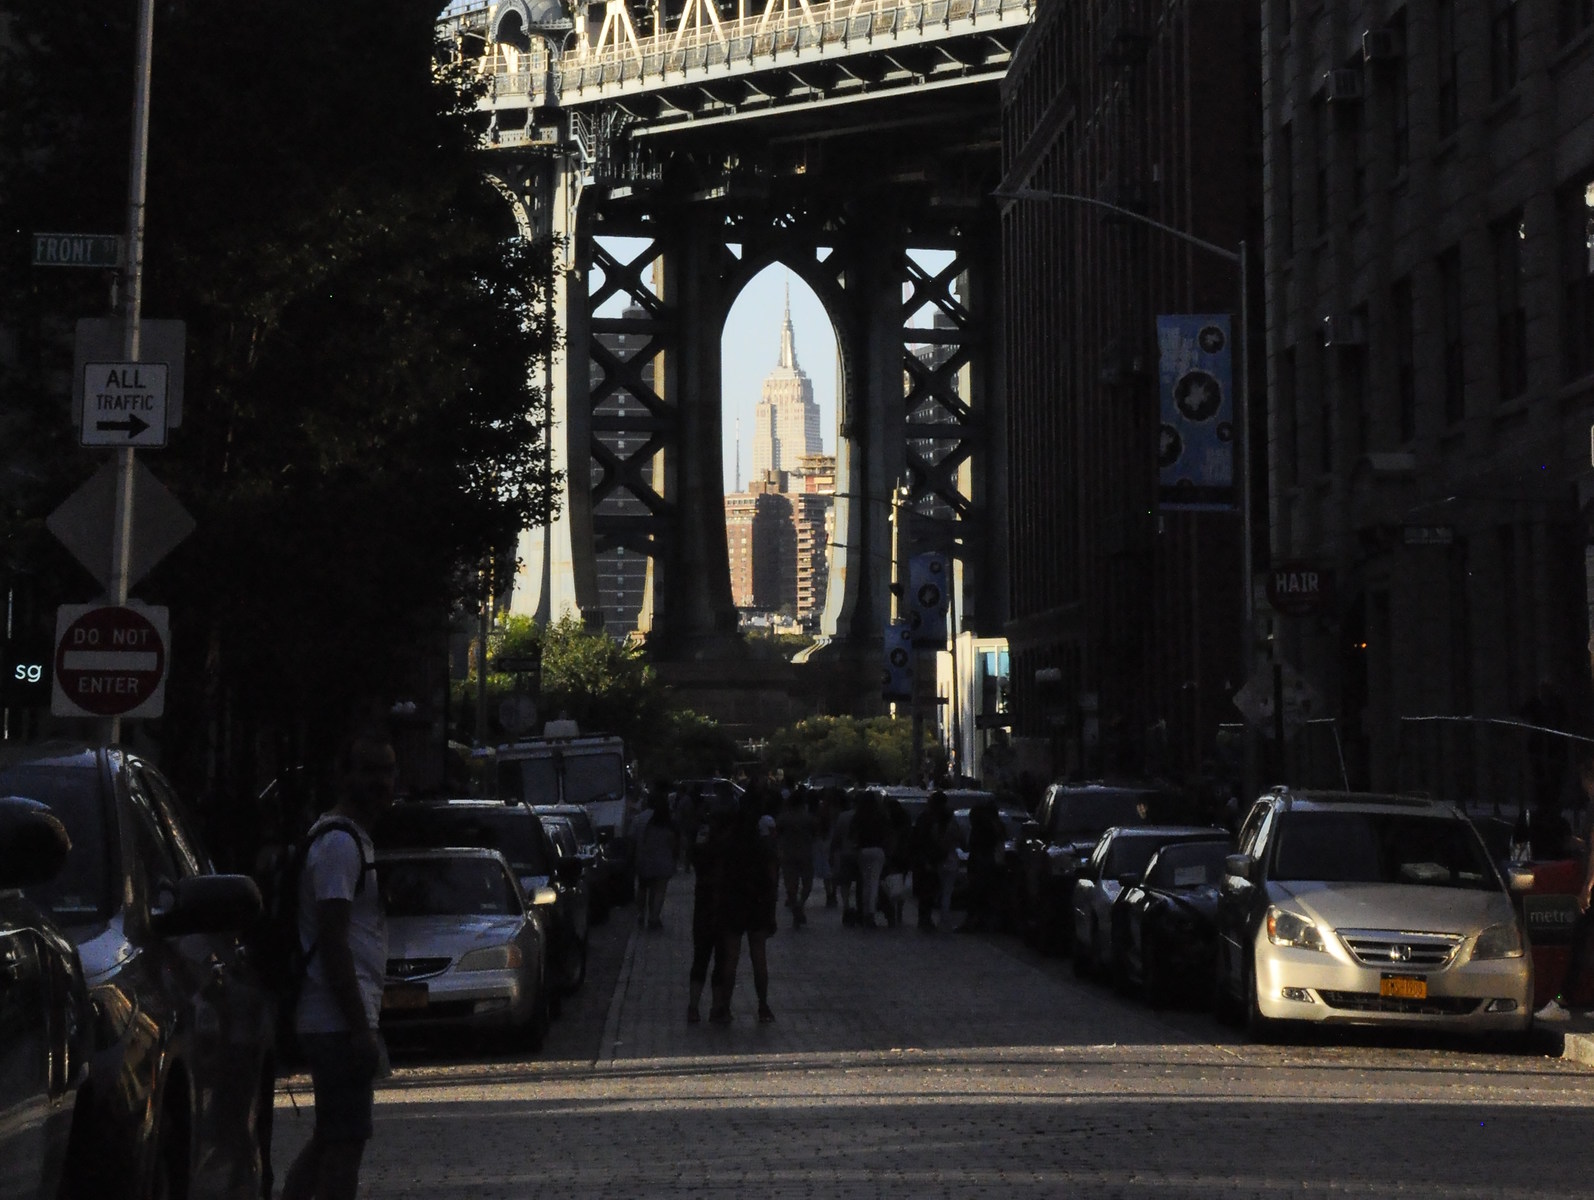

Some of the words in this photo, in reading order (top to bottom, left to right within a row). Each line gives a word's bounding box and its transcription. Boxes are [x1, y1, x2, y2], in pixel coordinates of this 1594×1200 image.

[36, 237, 93, 261] FRONT
[106, 369, 146, 388] ALL
[97, 394, 153, 410] TRAFFIC
[1276, 572, 1319, 592] HAIR
[73, 628, 99, 644] DO
[113, 628, 149, 645] NOT
[14, 663, 43, 682] sg
[78, 677, 138, 693] ENTER
